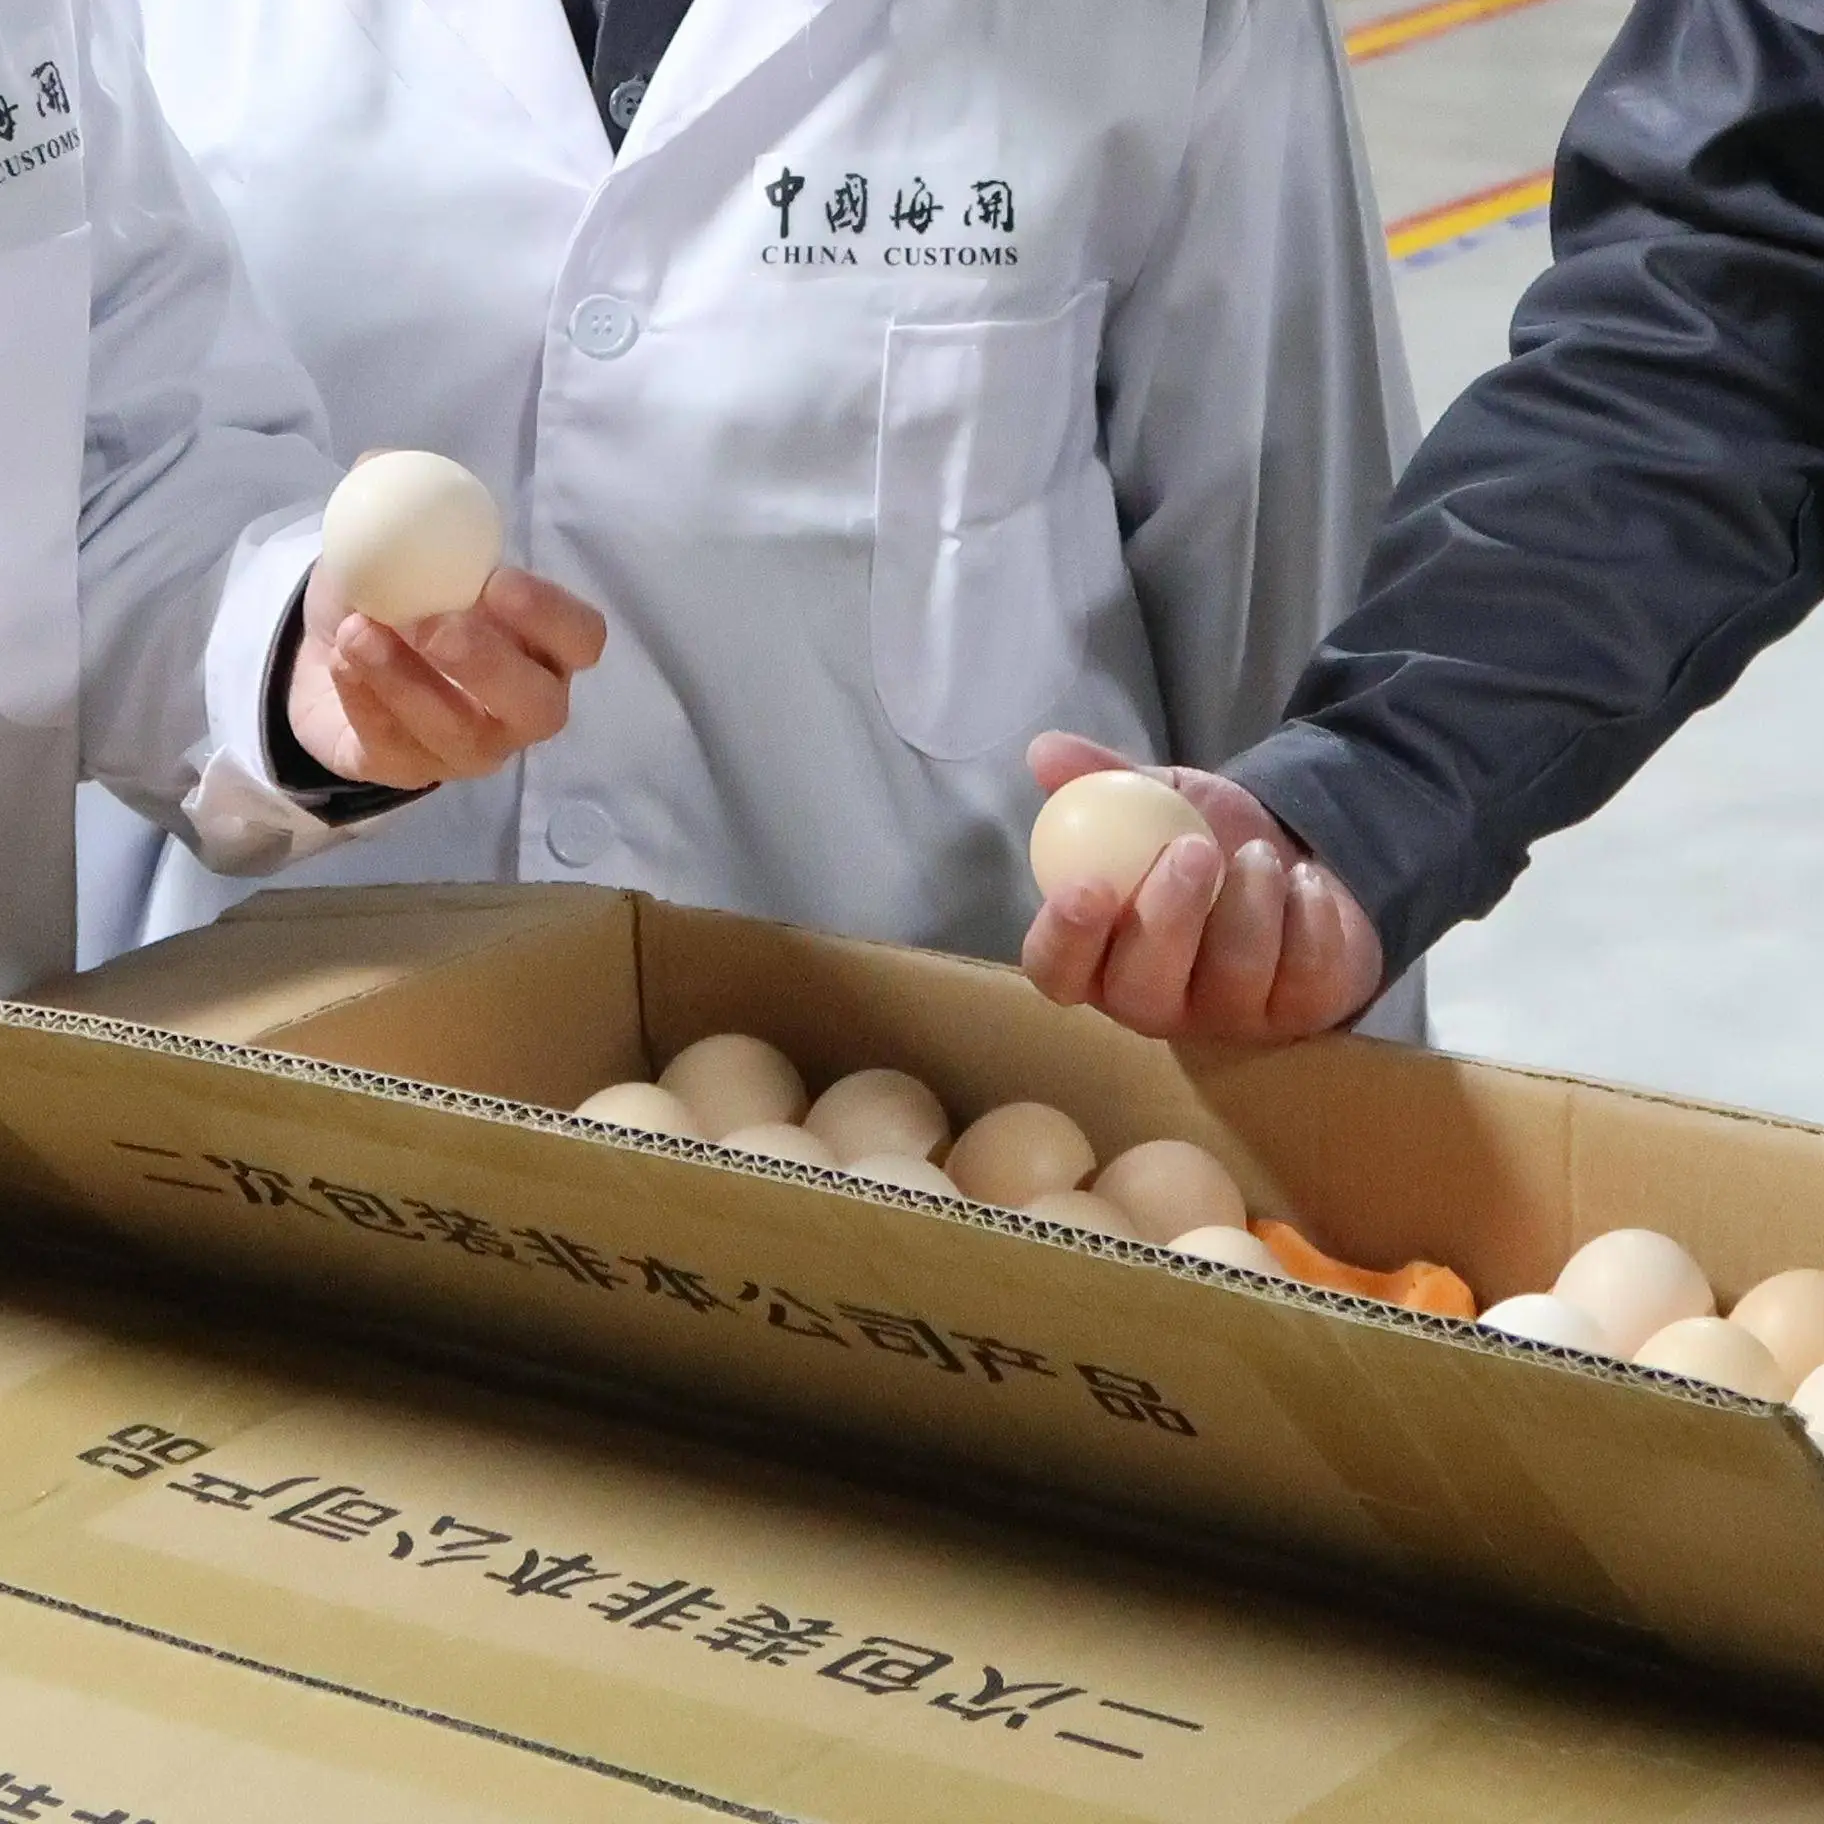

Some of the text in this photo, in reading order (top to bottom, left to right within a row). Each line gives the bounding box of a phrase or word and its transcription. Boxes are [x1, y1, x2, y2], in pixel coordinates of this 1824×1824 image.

[762, 245, 1018, 267] CHINA CUSTOMS
[112, 1138, 1198, 1438] 二次包装非本公司产品
[75, 1422, 1205, 1760] 二次包装非本公司产品
